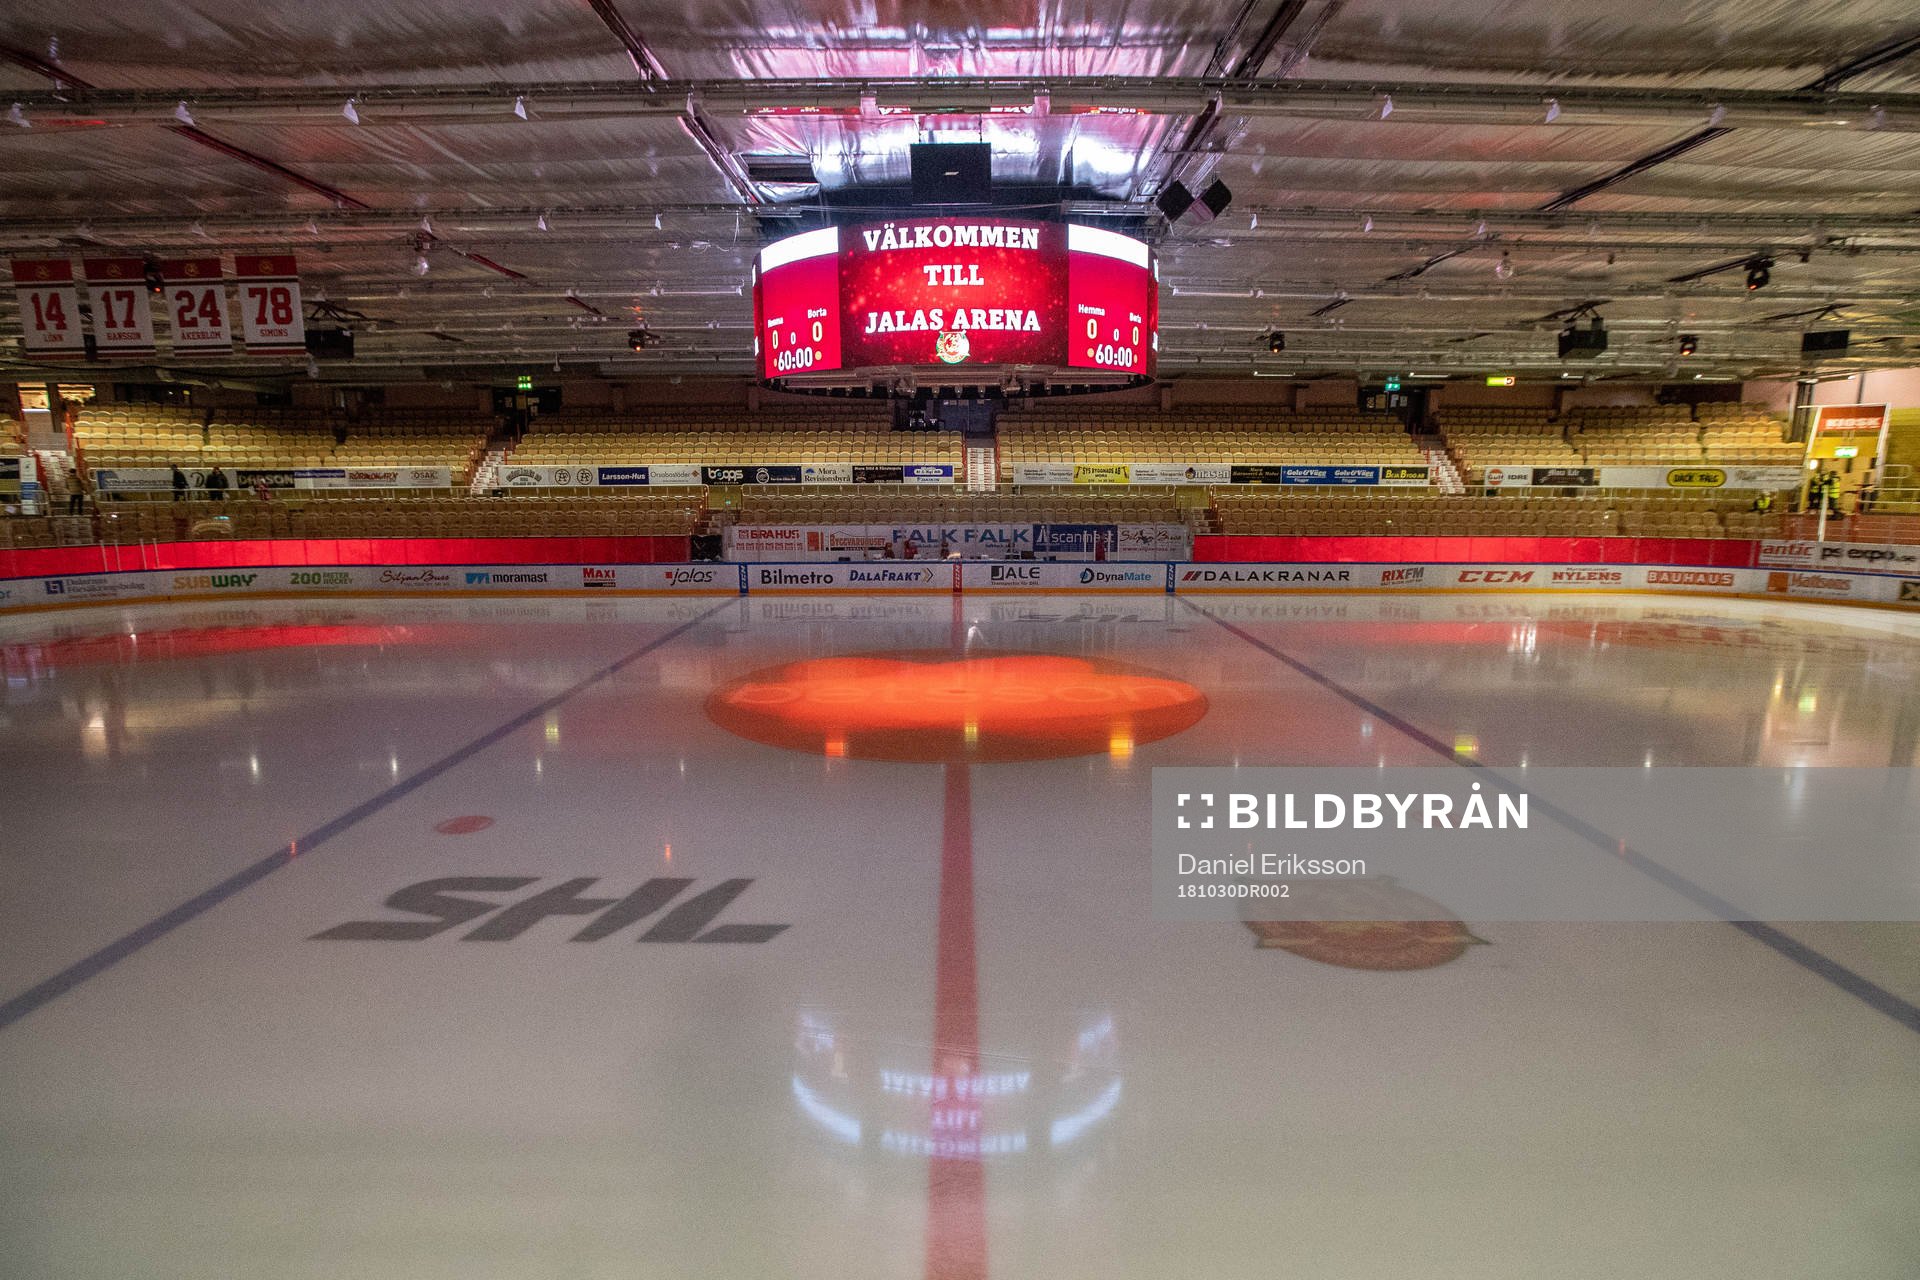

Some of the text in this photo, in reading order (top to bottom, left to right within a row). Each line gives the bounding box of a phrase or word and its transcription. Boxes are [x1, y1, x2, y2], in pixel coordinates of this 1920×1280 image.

[863, 224, 1039, 251] VÄLKOMMEN
[923, 264, 985, 286] TILL
[31, 292, 68, 331] 14
[101, 290, 136, 329] 17
[174, 288, 222, 328] 24
[247, 287, 293, 325] 78
[807, 307, 827, 319] Borta
[864, 309, 1041, 334] JALAS ARENA
[1086, 318, 1098, 340] 0
[260, 329, 289, 337] SIMONS
[772, 329, 779, 350] 0
[812, 321, 823, 342] 0
[1132, 326, 1139, 346] 0
[778, 346, 814, 372] 60:00
[1095, 343, 1133, 368] 60:00
[601, 472, 646, 480] Larsson-Hus
[818, 467, 837, 475] Mora
[892, 529, 1031, 543] FALK FALK
[1051, 530, 1115, 543] scanmst
[173, 574, 258, 589] SUBWAY
[290, 572, 322, 584] 200
[492, 572, 548, 583] moramast
[671, 568, 713, 587] jalas
[760, 569, 834, 585] Bilmetro
[849, 569, 922, 582] DALAFRAKT
[1096, 572, 1152, 583] DynaMate
[1203, 570, 1350, 582] DALAKRANAR
[1457, 571, 1535, 583] CCM
[1551, 572, 1623, 581] NYLENS
[1648, 572, 1734, 585] BAUHAUS
[305, 877, 793, 943] SHL
